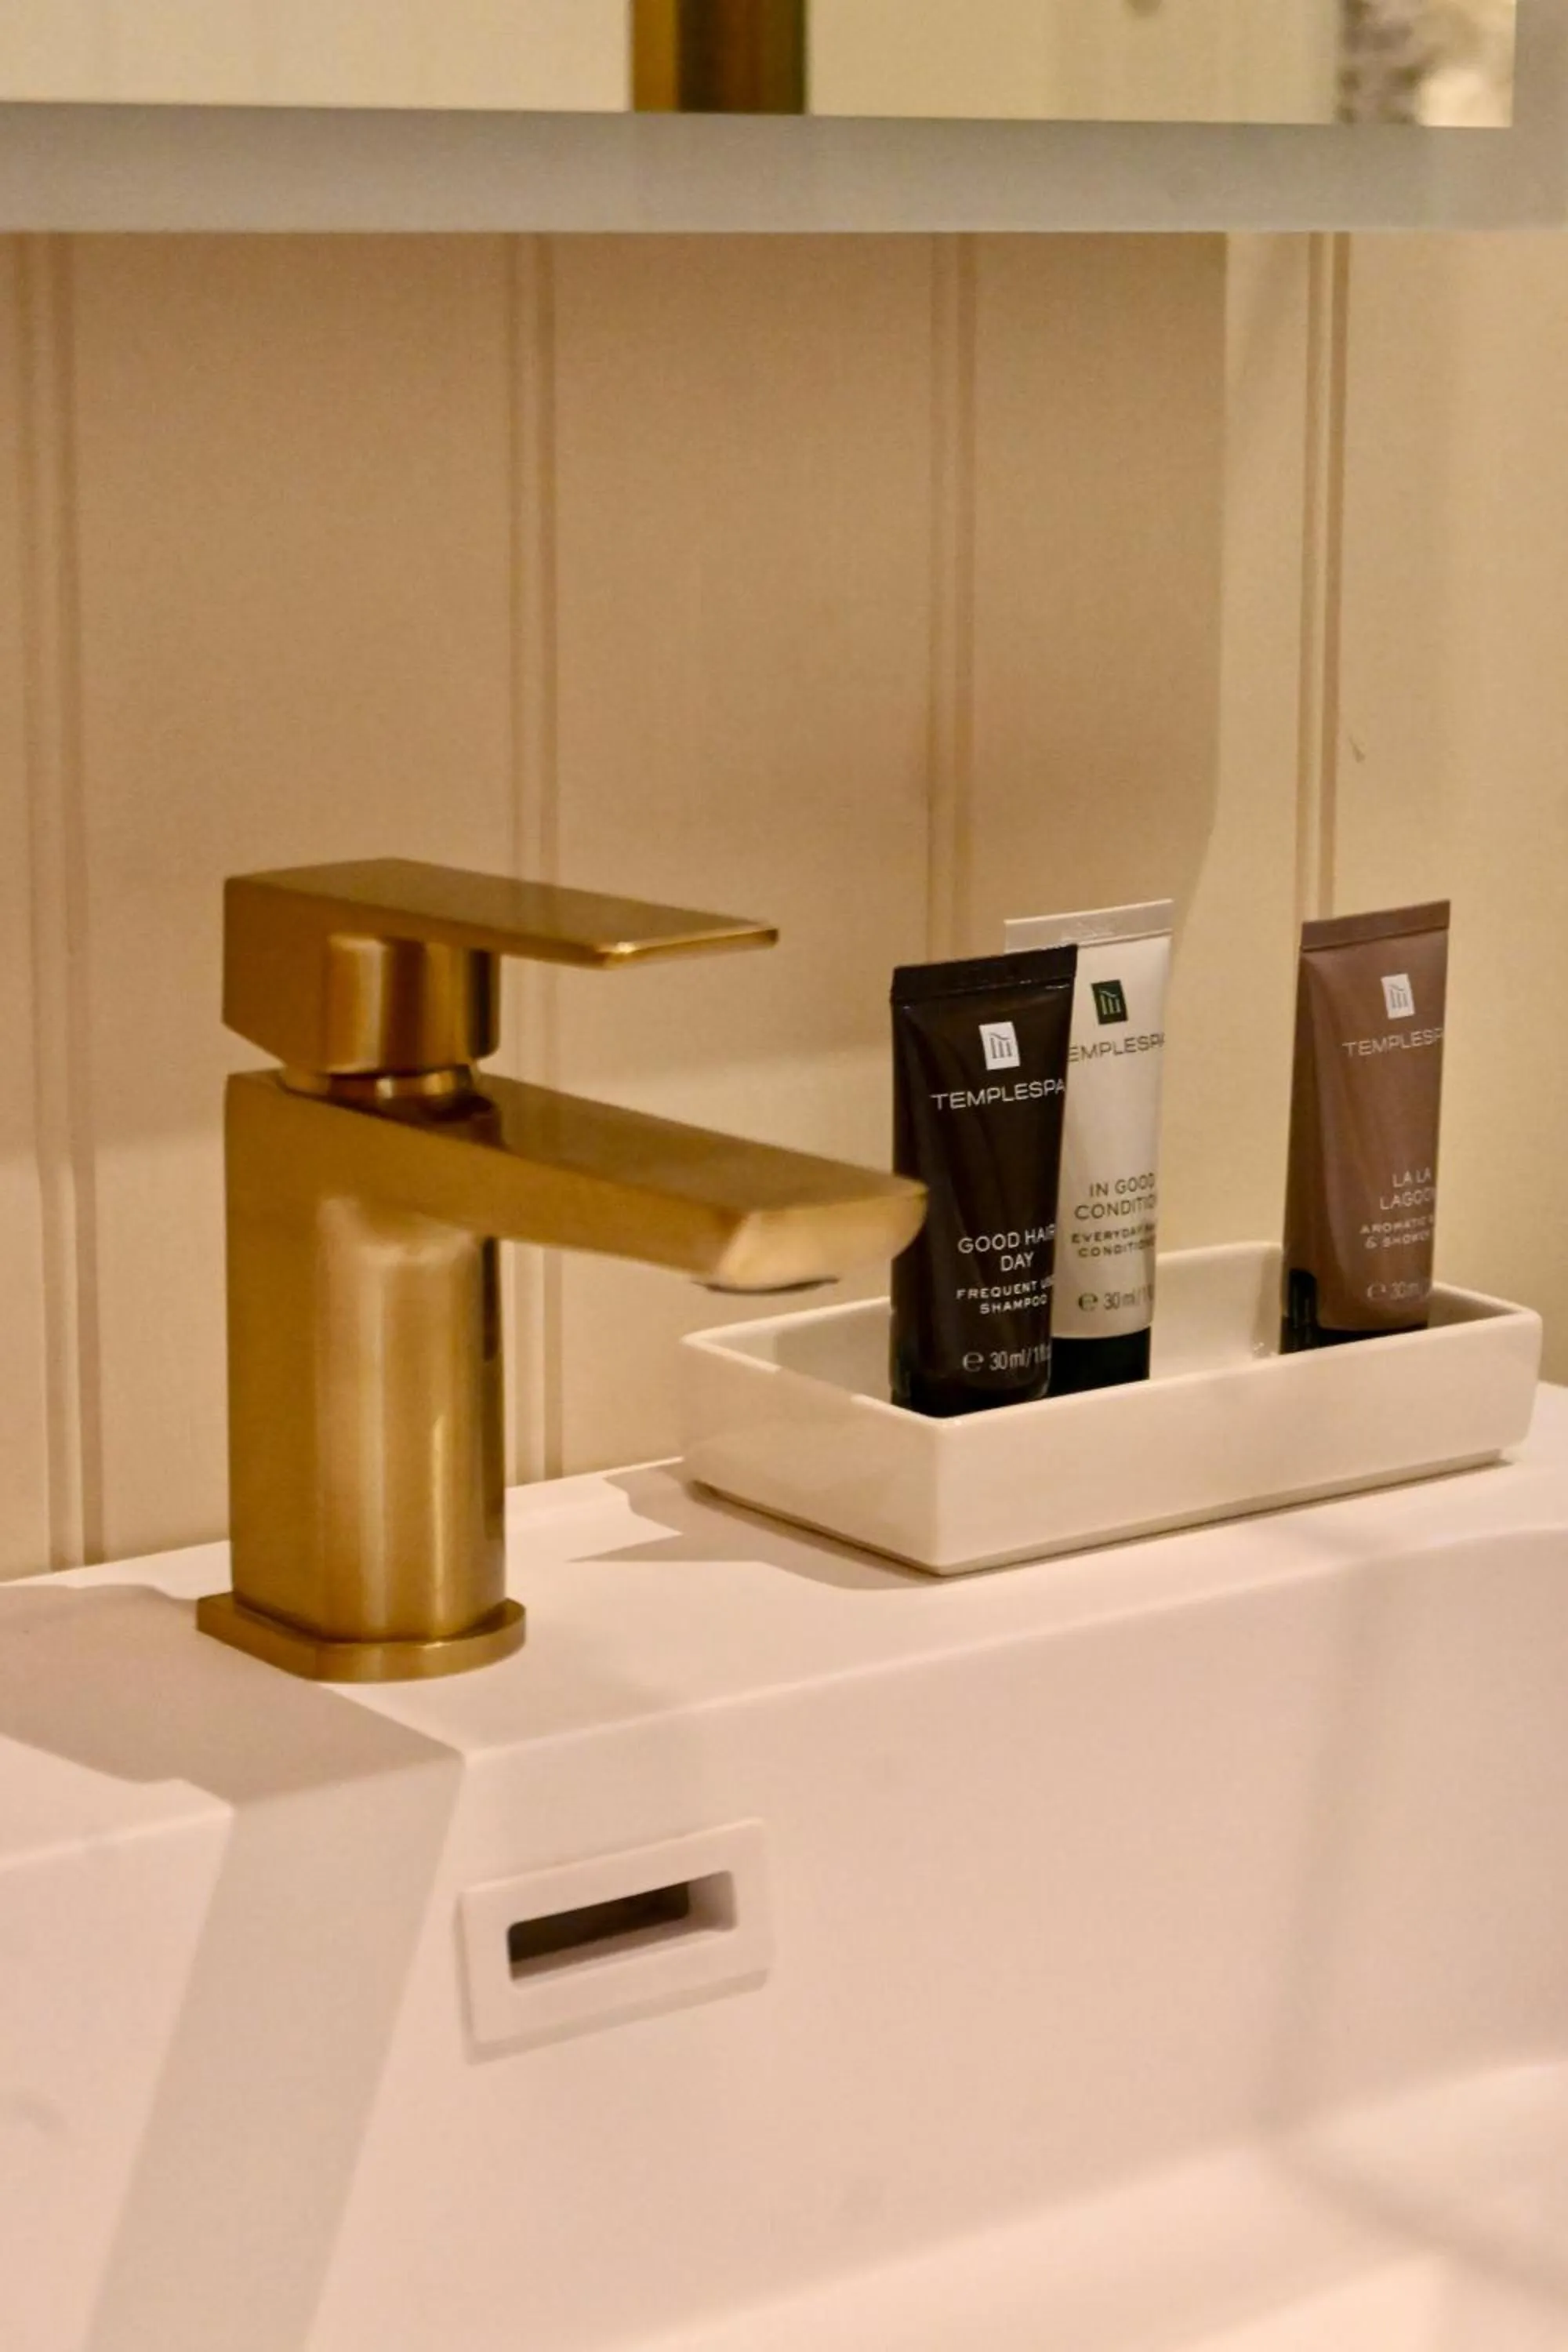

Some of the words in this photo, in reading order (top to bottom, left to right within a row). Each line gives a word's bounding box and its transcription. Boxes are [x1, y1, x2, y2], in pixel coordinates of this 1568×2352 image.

[1089, 1181, 1109, 1198] IN
[1392, 1171, 1412, 1188] LA
[1074, 1193, 1156, 1220] CONDITIO
[1380, 1187, 1436, 1210] LAGOO
[957, 1231, 1020, 1254] GOOD
[1000, 1251, 1034, 1272] DAY
[956, 1280, 1039, 1301] FREQUENT
[980, 1294, 1047, 1316] SHAMPOO
